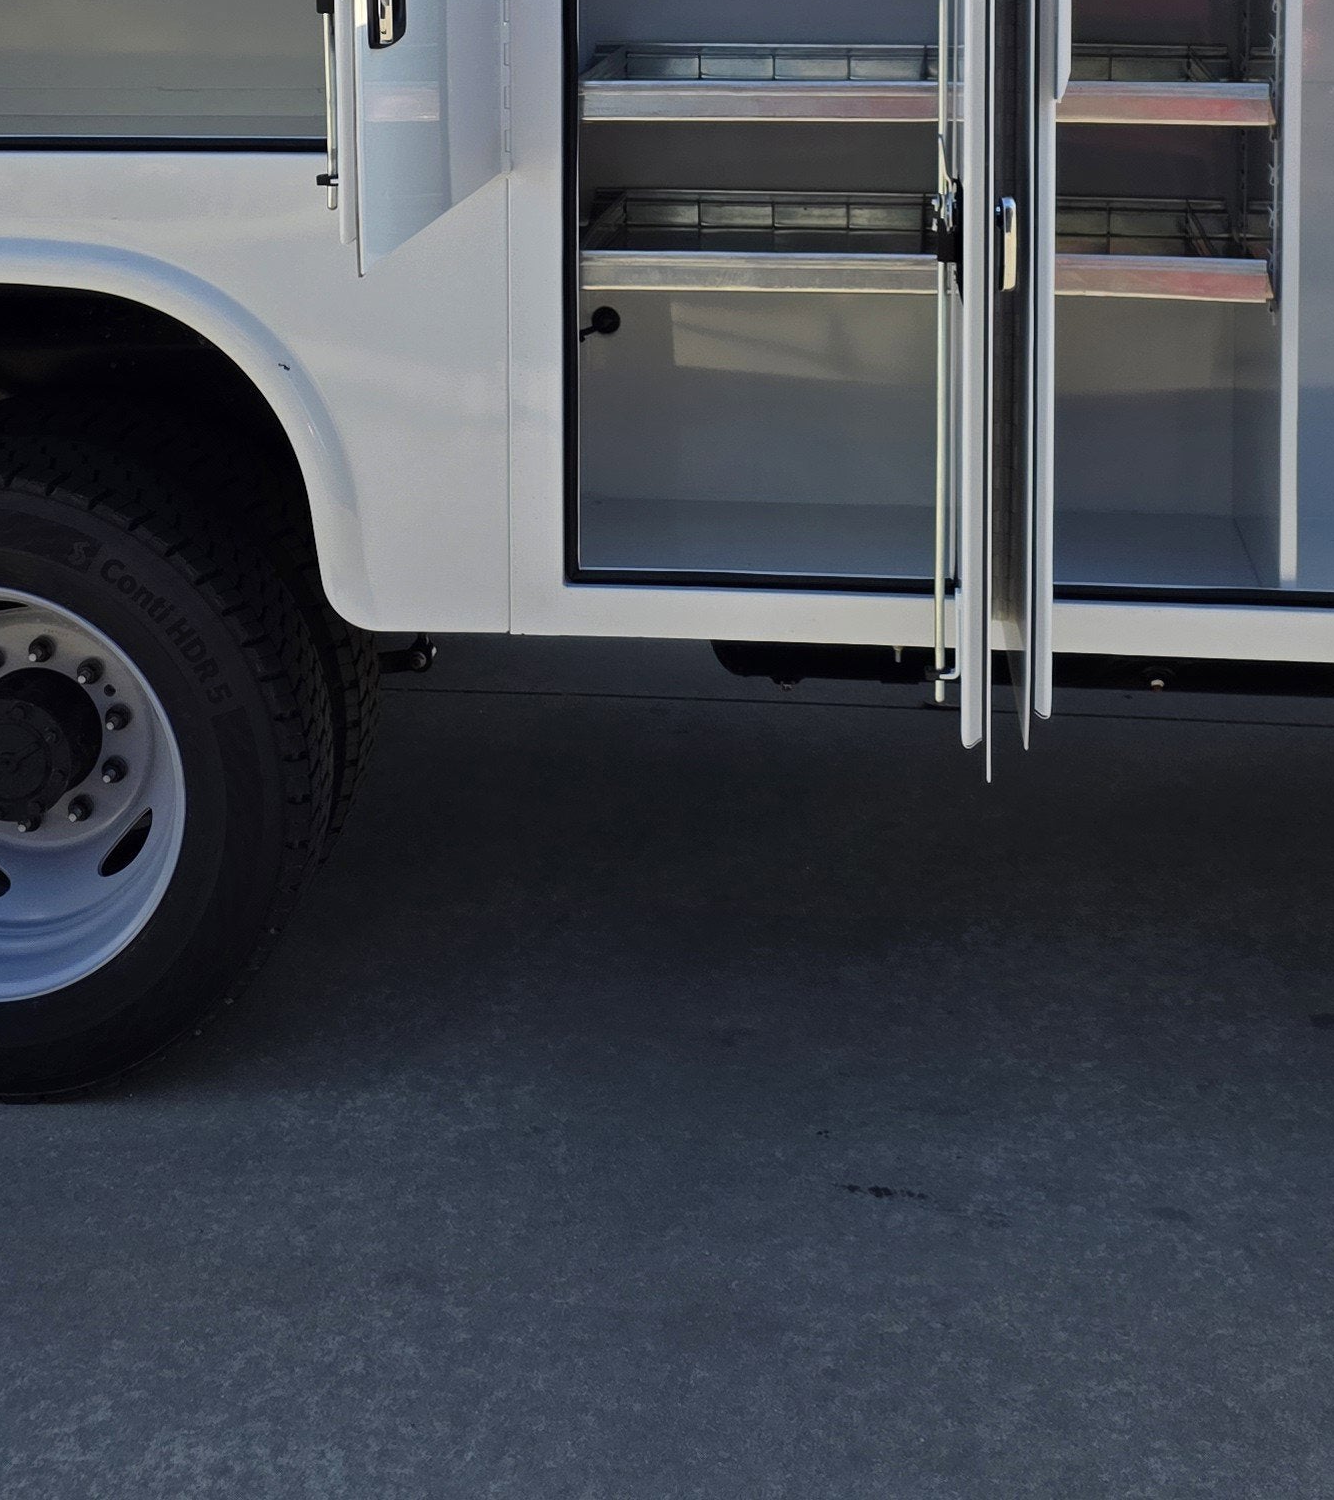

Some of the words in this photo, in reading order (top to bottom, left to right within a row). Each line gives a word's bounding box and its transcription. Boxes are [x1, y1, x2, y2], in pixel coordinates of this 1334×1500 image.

[100, 558, 175, 625] Conti
[165, 617, 219, 684] HDR
[206, 682, 233, 705] 5
